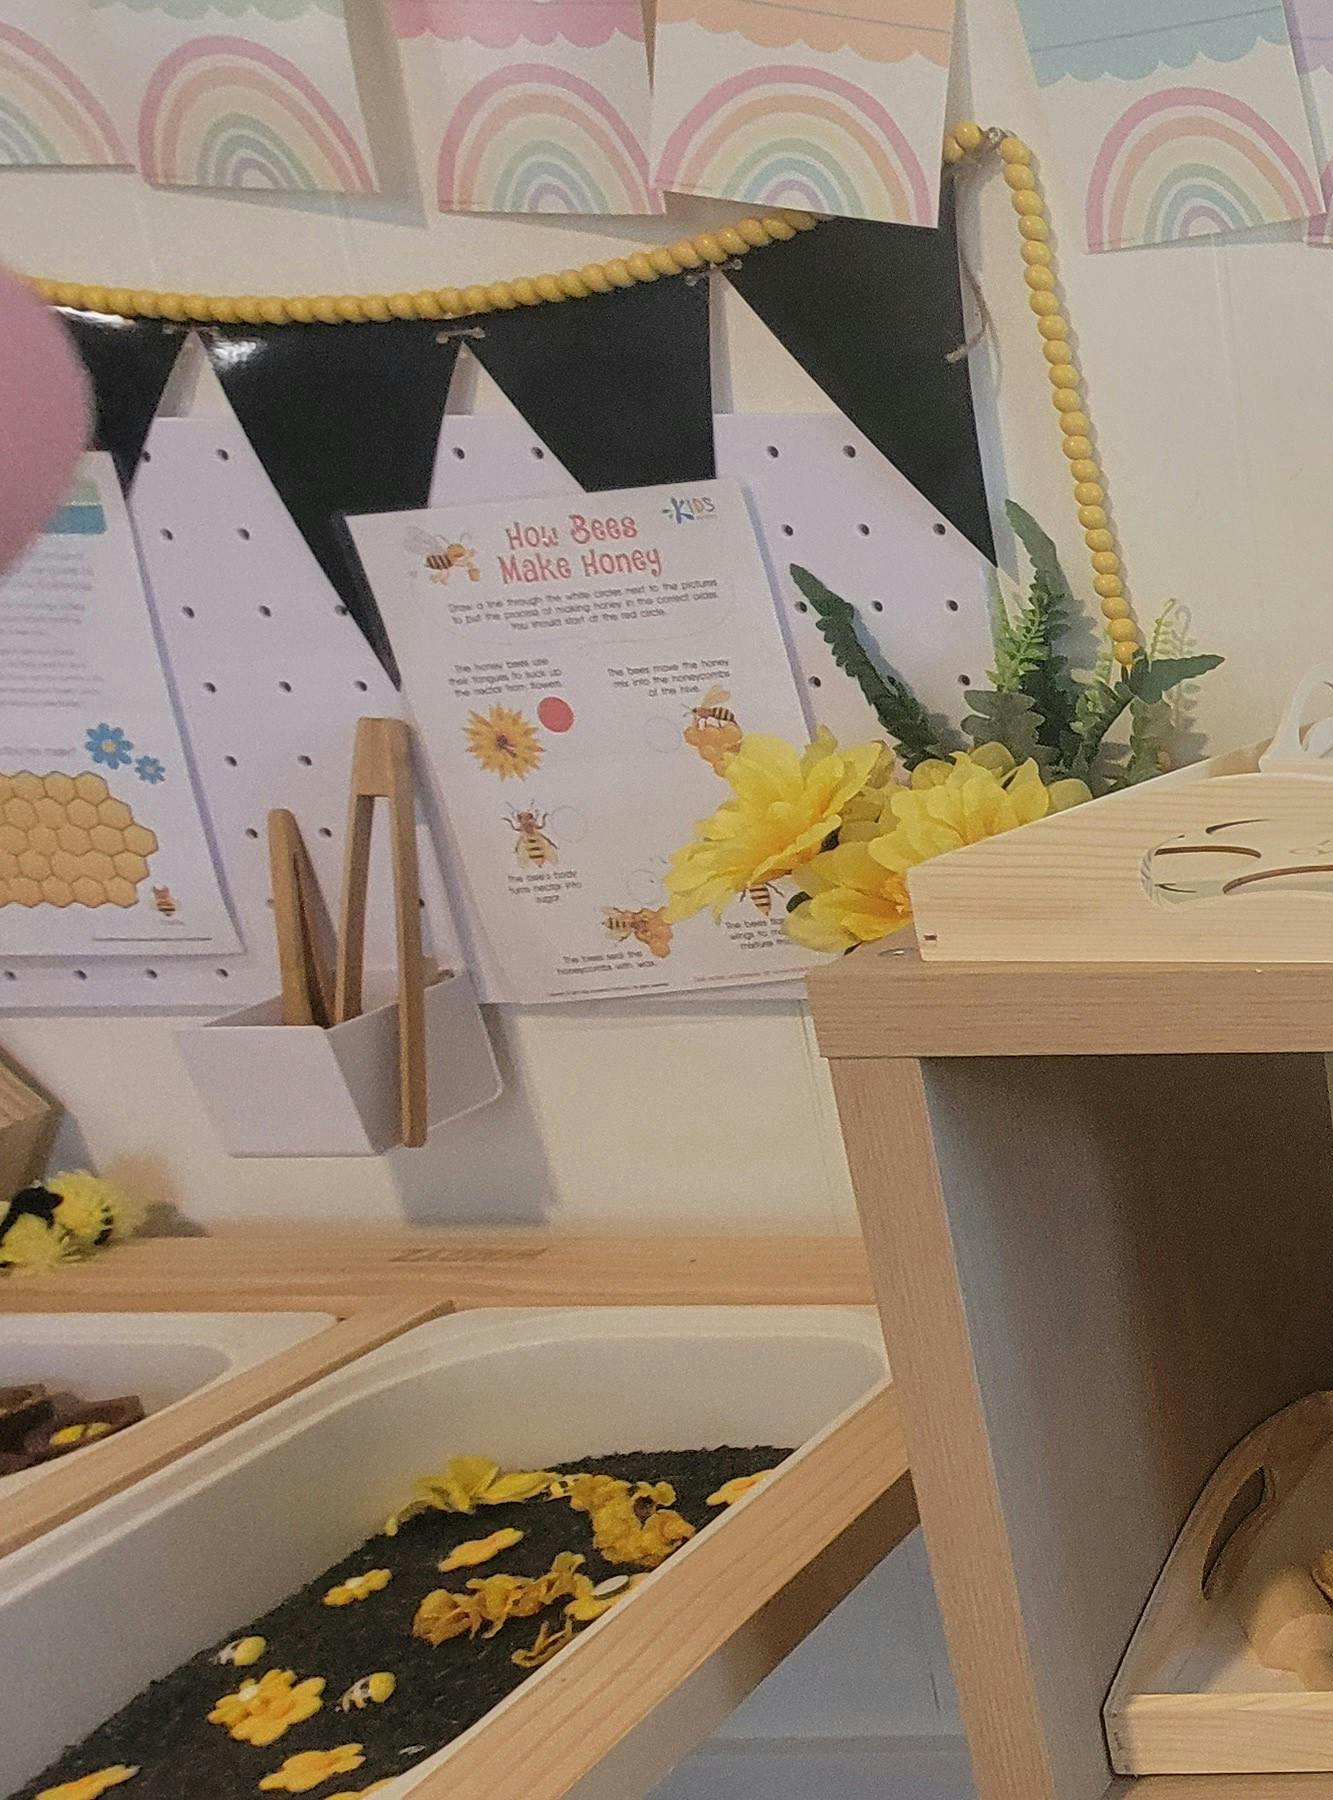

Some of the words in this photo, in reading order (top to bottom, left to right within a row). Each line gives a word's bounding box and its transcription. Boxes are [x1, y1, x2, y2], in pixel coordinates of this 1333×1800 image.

[505, 521, 559, 550] How
[568, 514, 638, 544] Bees
[496, 552, 572, 584] Make
[580, 548, 662, 577] Honey
